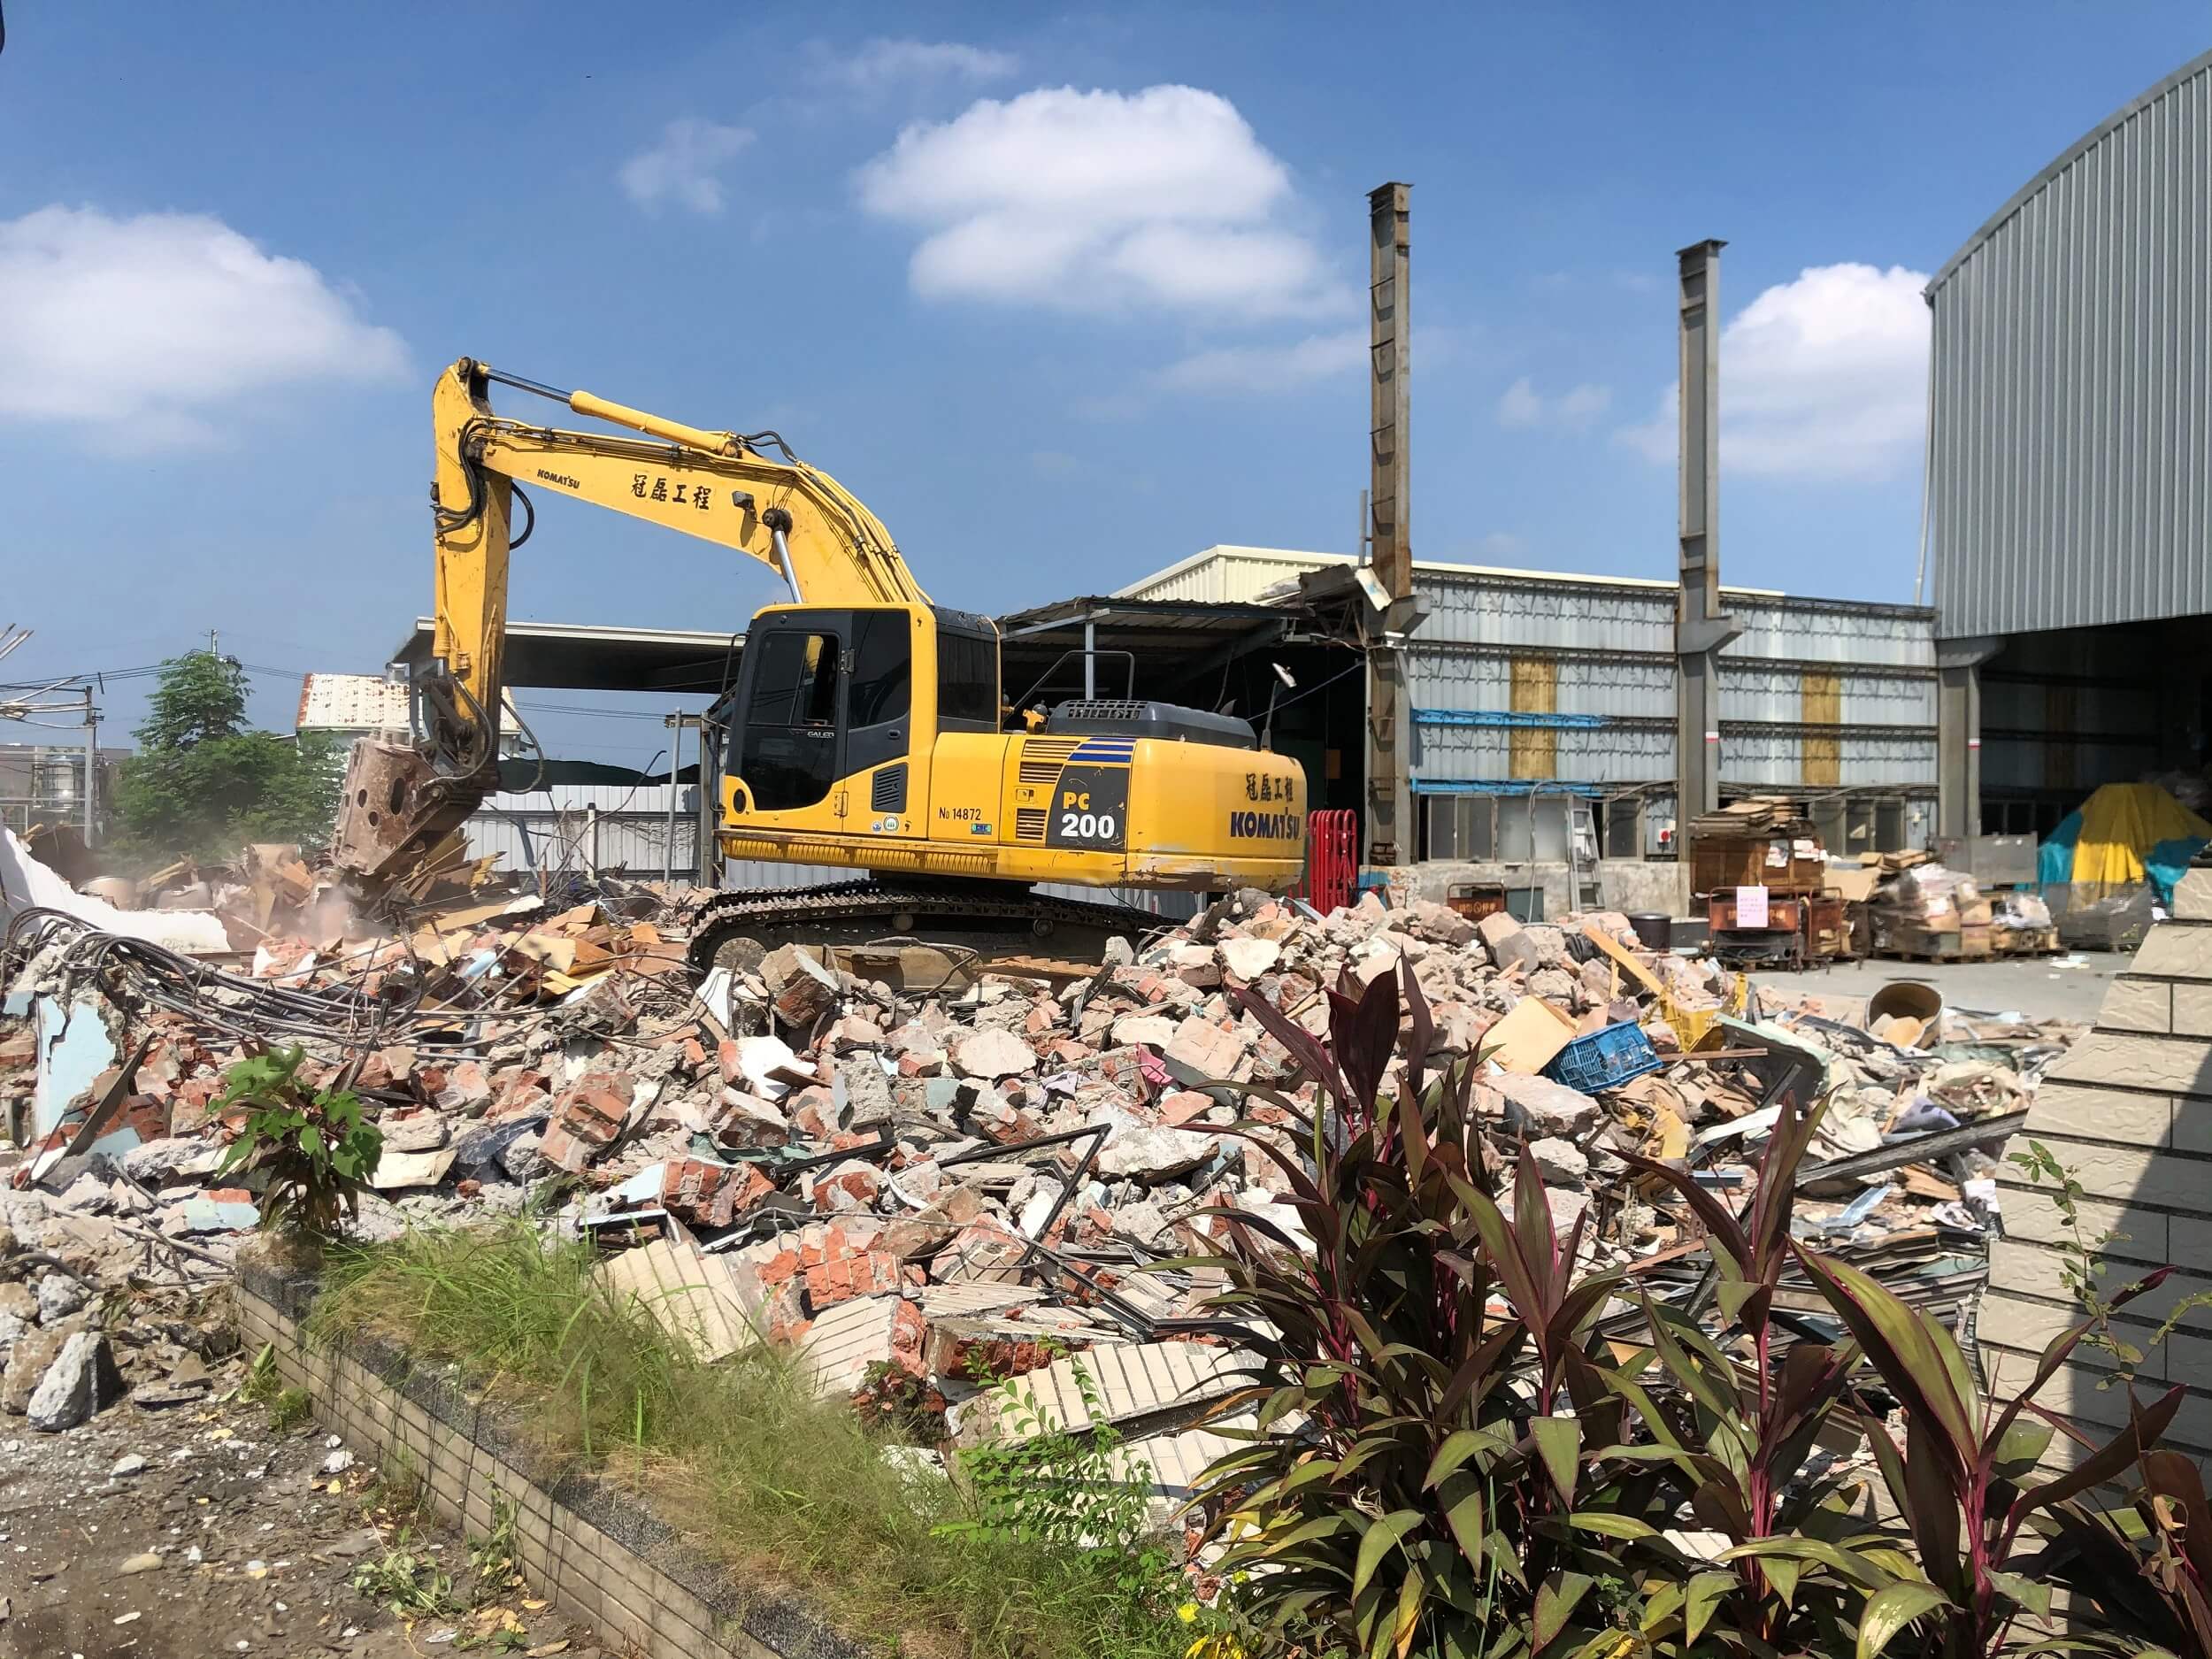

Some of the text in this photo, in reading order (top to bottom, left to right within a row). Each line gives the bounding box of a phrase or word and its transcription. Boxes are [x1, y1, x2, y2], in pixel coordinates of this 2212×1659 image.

[537, 469, 580, 489] KOMATSU
[631, 473, 711, 510] 冠磊工程
[1246, 773, 1294, 803] 冠磊工程
[1063, 792, 1090, 810] PC
[952, 808, 981, 820] 14872
[1061, 814, 1115, 839] 200
[1231, 807, 1300, 841] KOMATSU
